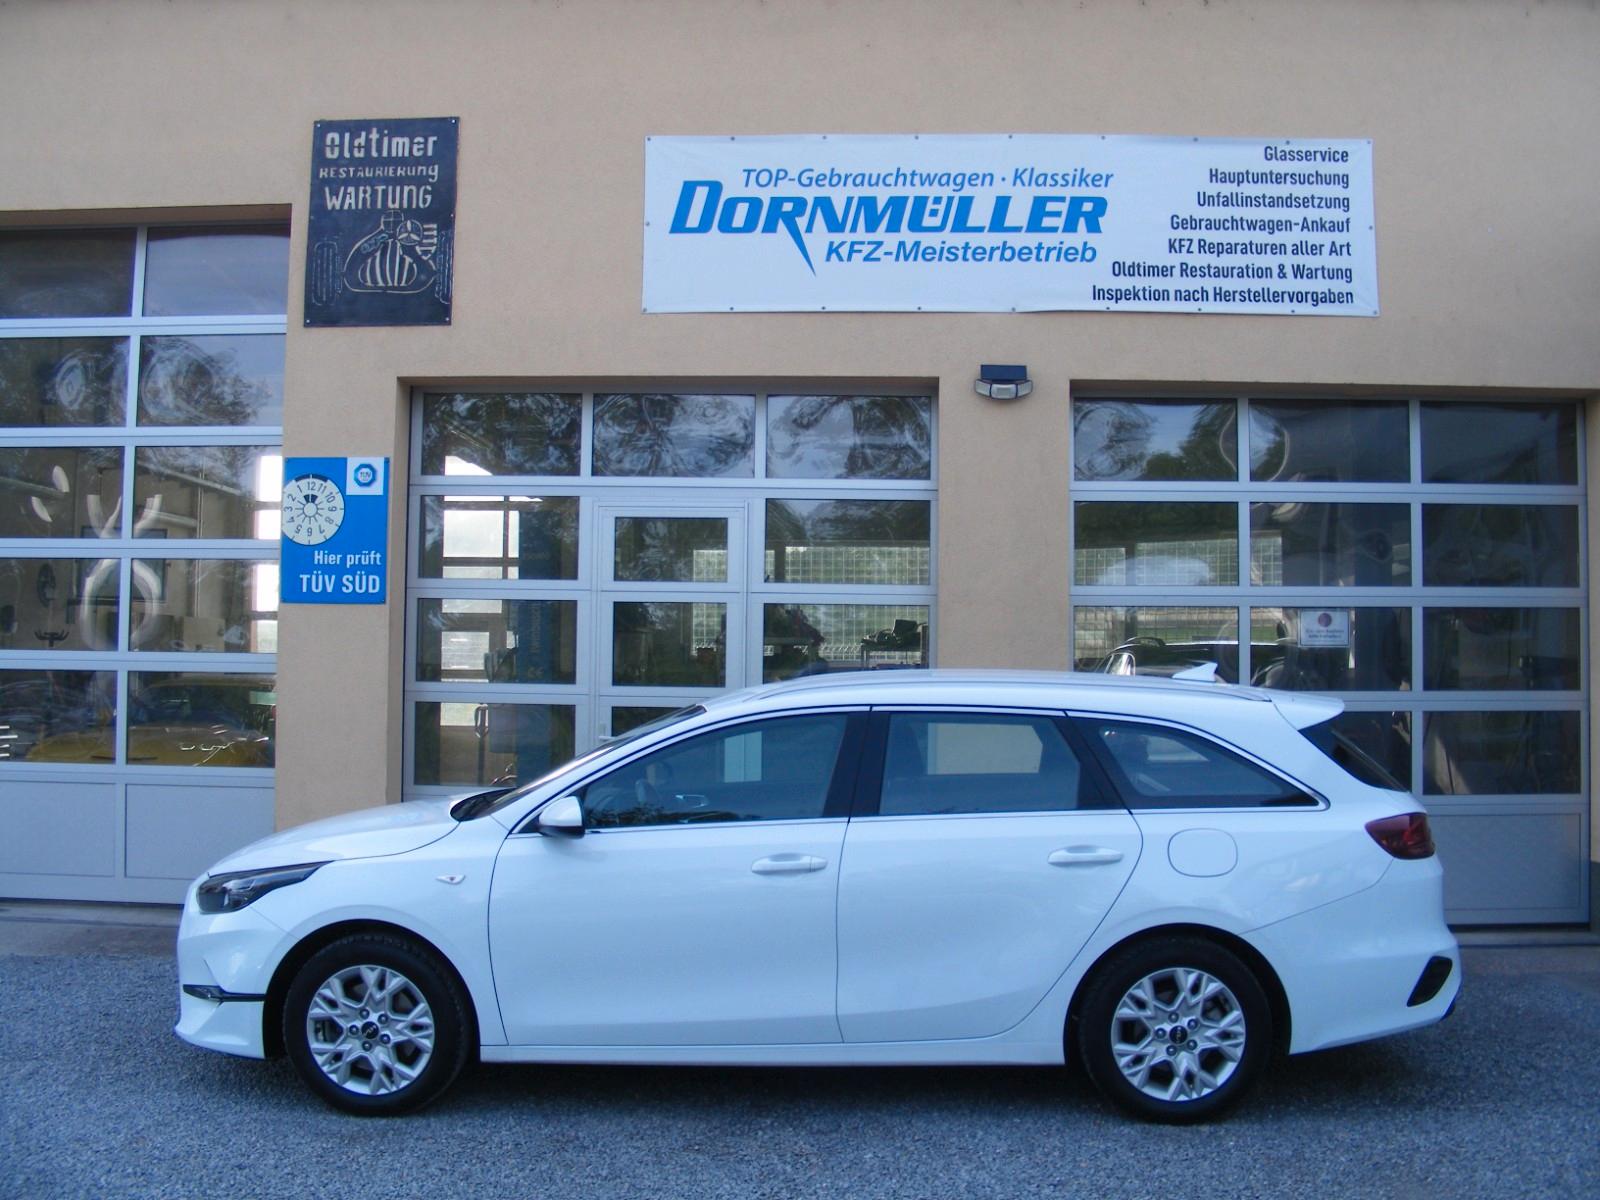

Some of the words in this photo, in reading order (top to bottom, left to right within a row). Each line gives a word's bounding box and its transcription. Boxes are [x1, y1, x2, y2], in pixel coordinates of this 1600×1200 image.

[325, 127, 437, 159] Oldtimer
[1264, 146, 1349, 163] Glasservice
[741, 168, 994, 189] TOP-Gebrauchtwagen
[1012, 168, 1114, 188] Klassiker
[1209, 168, 1350, 189] Hauptuntersuchung
[325, 185, 432, 210] WARTUNG
[1197, 191, 1350, 213] Unfallinstandsetzung
[1170, 214, 1351, 235] Gebrauchtwagen-Ankauf
[825, 240, 1097, 263] KFZ-Meisterbetrieb
[1168, 238, 1194, 254] KFZ
[1198, 239, 1287, 257] Reparaturen
[1291, 241, 1326, 256] aller
[1329, 242, 1352, 257] Art
[1112, 261, 1176, 277] Oldtimer
[1180, 263, 1273, 279] Restauration
[1278, 265, 1288, 279] &
[1292, 265, 1353, 283] Wartung
[1092, 285, 1170, 303] Inspektion
[1174, 287, 1209, 302] nach
[1213, 287, 1354, 307] Herstellervorgaben
[307, 481, 316, 491] 12
[314, 550, 342, 565] Hier
[346, 550, 381, 568] prüft
[300, 571, 336, 593] TÜV
[341, 571, 380, 593] SÜD
